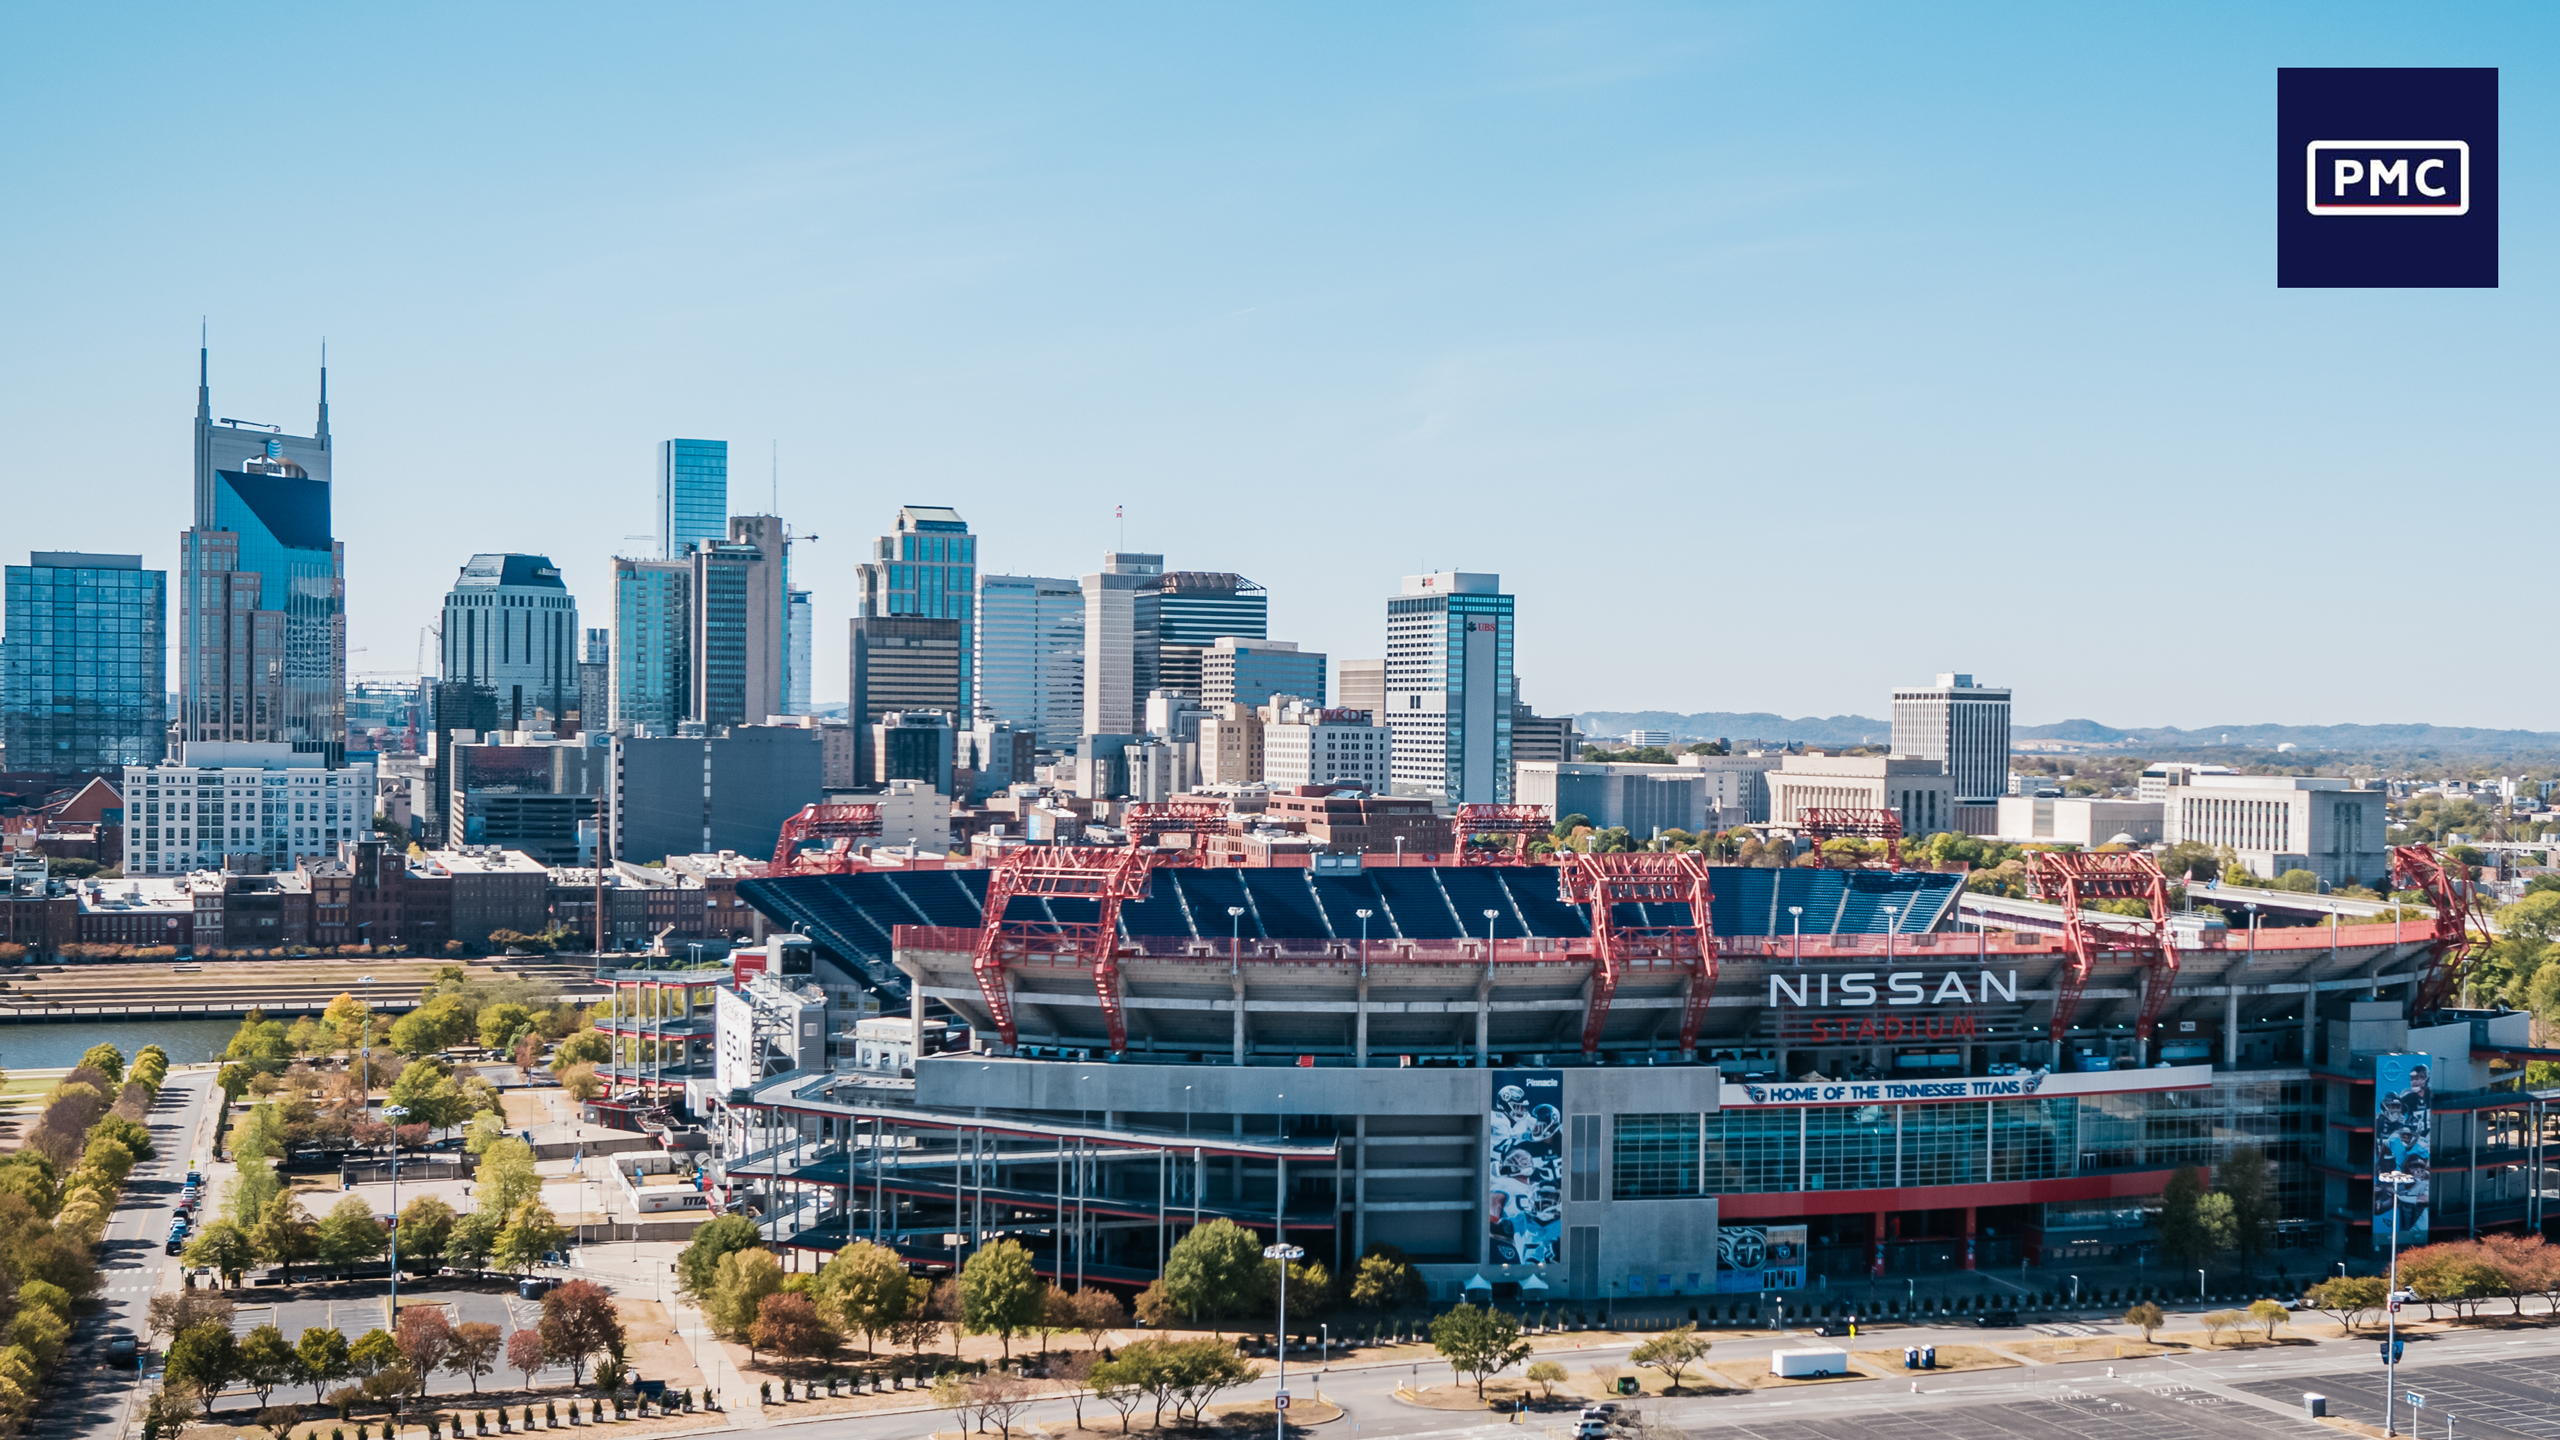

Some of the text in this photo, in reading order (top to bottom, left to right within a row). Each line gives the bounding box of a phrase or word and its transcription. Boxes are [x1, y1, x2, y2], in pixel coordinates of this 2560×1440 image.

[1478, 622, 1496, 632] UBS
[1320, 709, 1373, 722] WKDF
[1769, 970, 2017, 1008] NISSAN
[1810, 1014, 1976, 1042] STADIUM
[1770, 1080, 2020, 1101] HOME OF THE TENNESSEE TITANS
[682, 1196, 708, 1206] TITA
[390, 1219, 396, 1228] J
[2392, 1302, 2399, 1312] C
[1277, 1396, 1289, 1409] D
